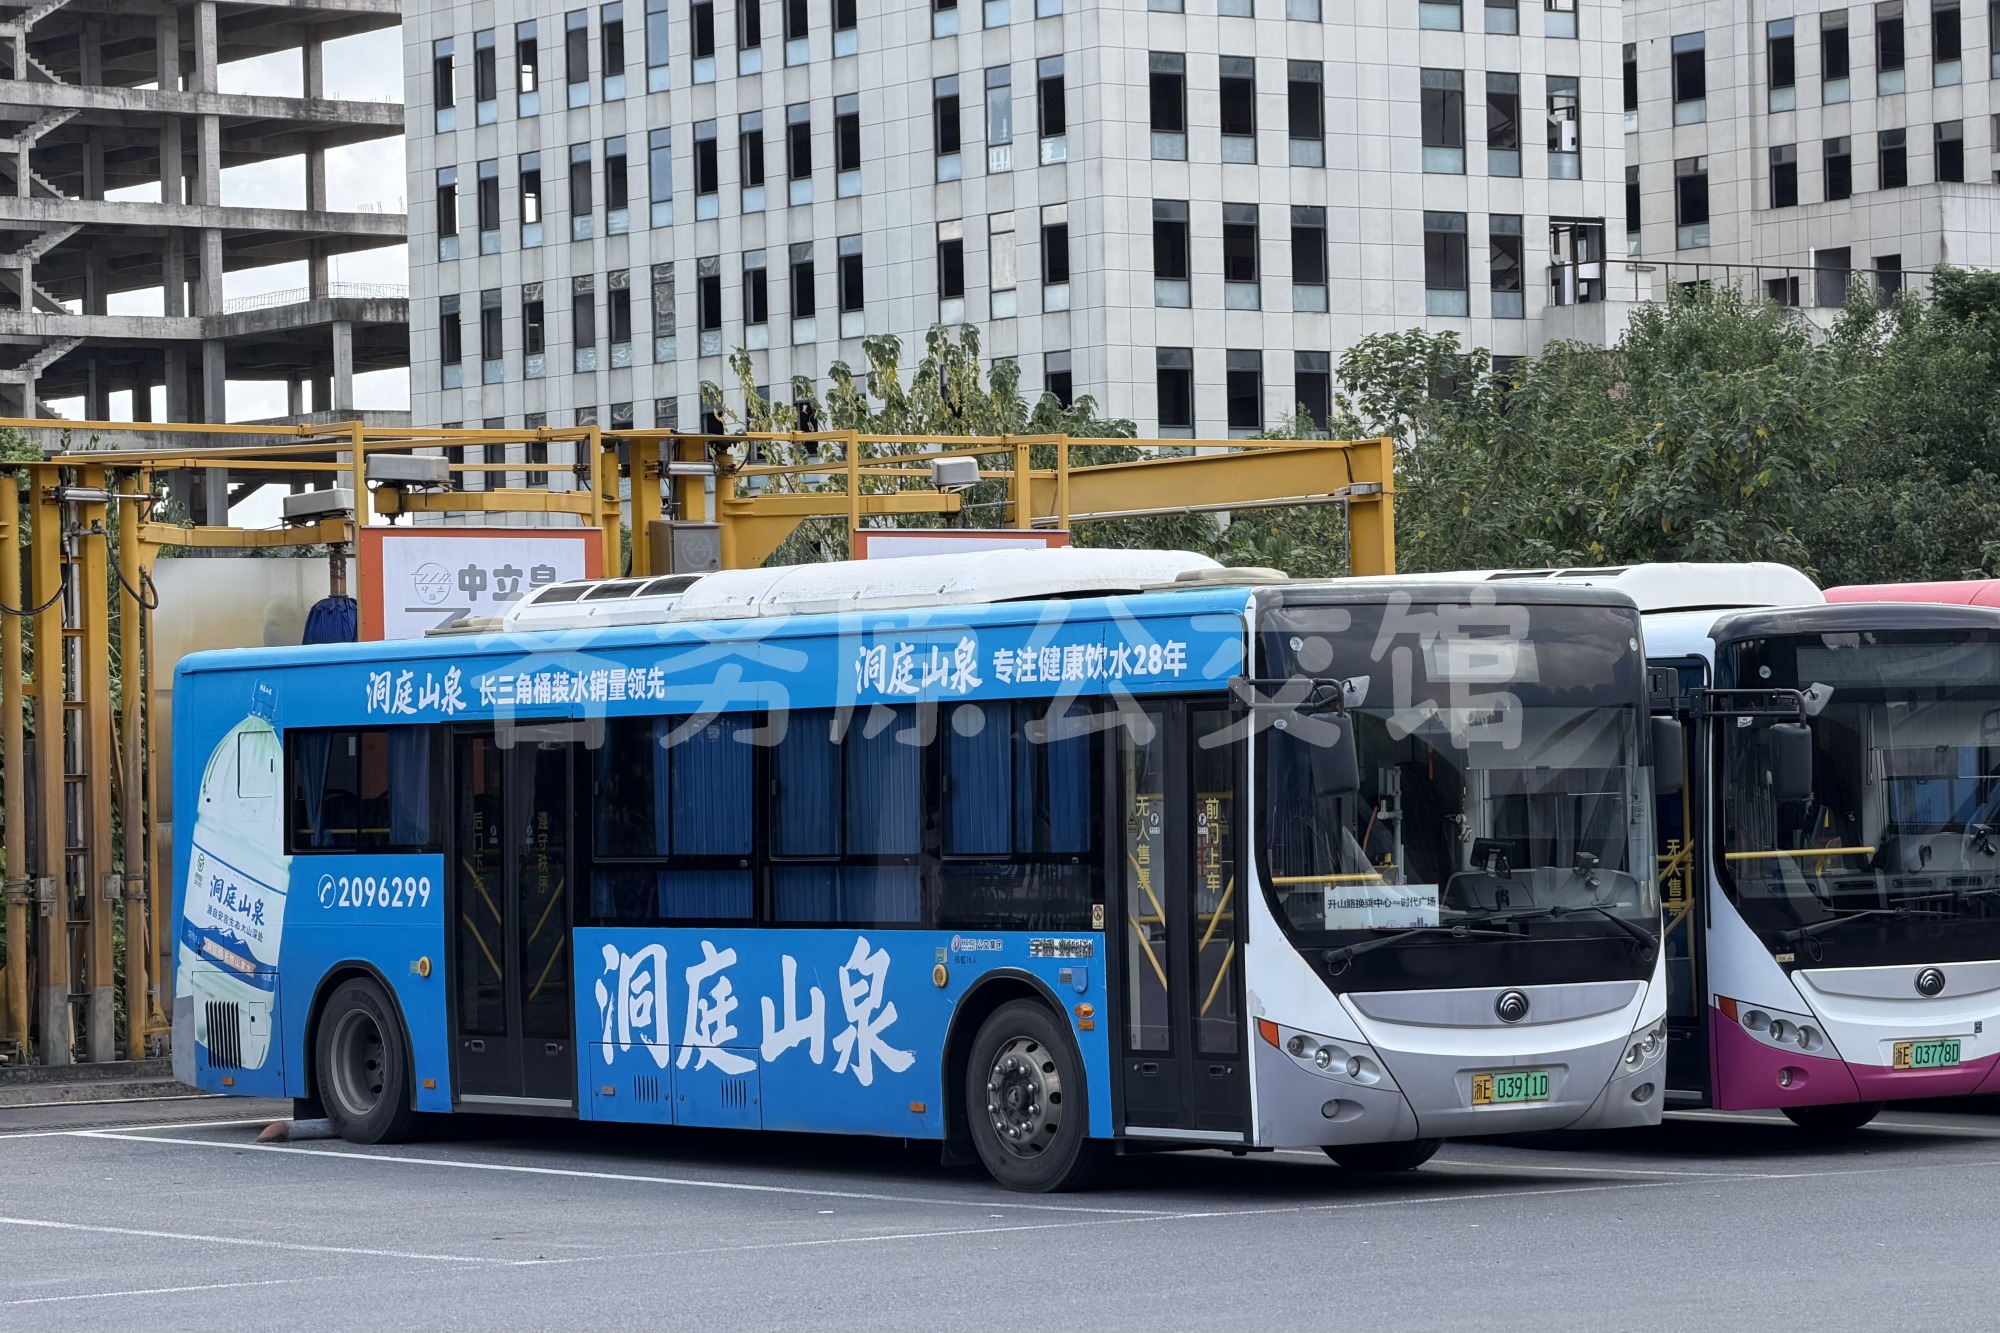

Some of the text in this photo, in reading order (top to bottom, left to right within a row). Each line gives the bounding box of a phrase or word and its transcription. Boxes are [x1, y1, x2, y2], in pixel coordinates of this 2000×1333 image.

[366, 665, 665, 715] 洞庭山泉 长三角桶装水销量领先
[852, 636, 1187, 694] 洞庭山泉 专注健康饮水28年
[1205, 797, 1220, 894] 前门上车
[209, 874, 265, 926] 洞庭山泉
[338, 876, 431, 908] 2096299
[595, 936, 916, 1086] 洞庭山泉
